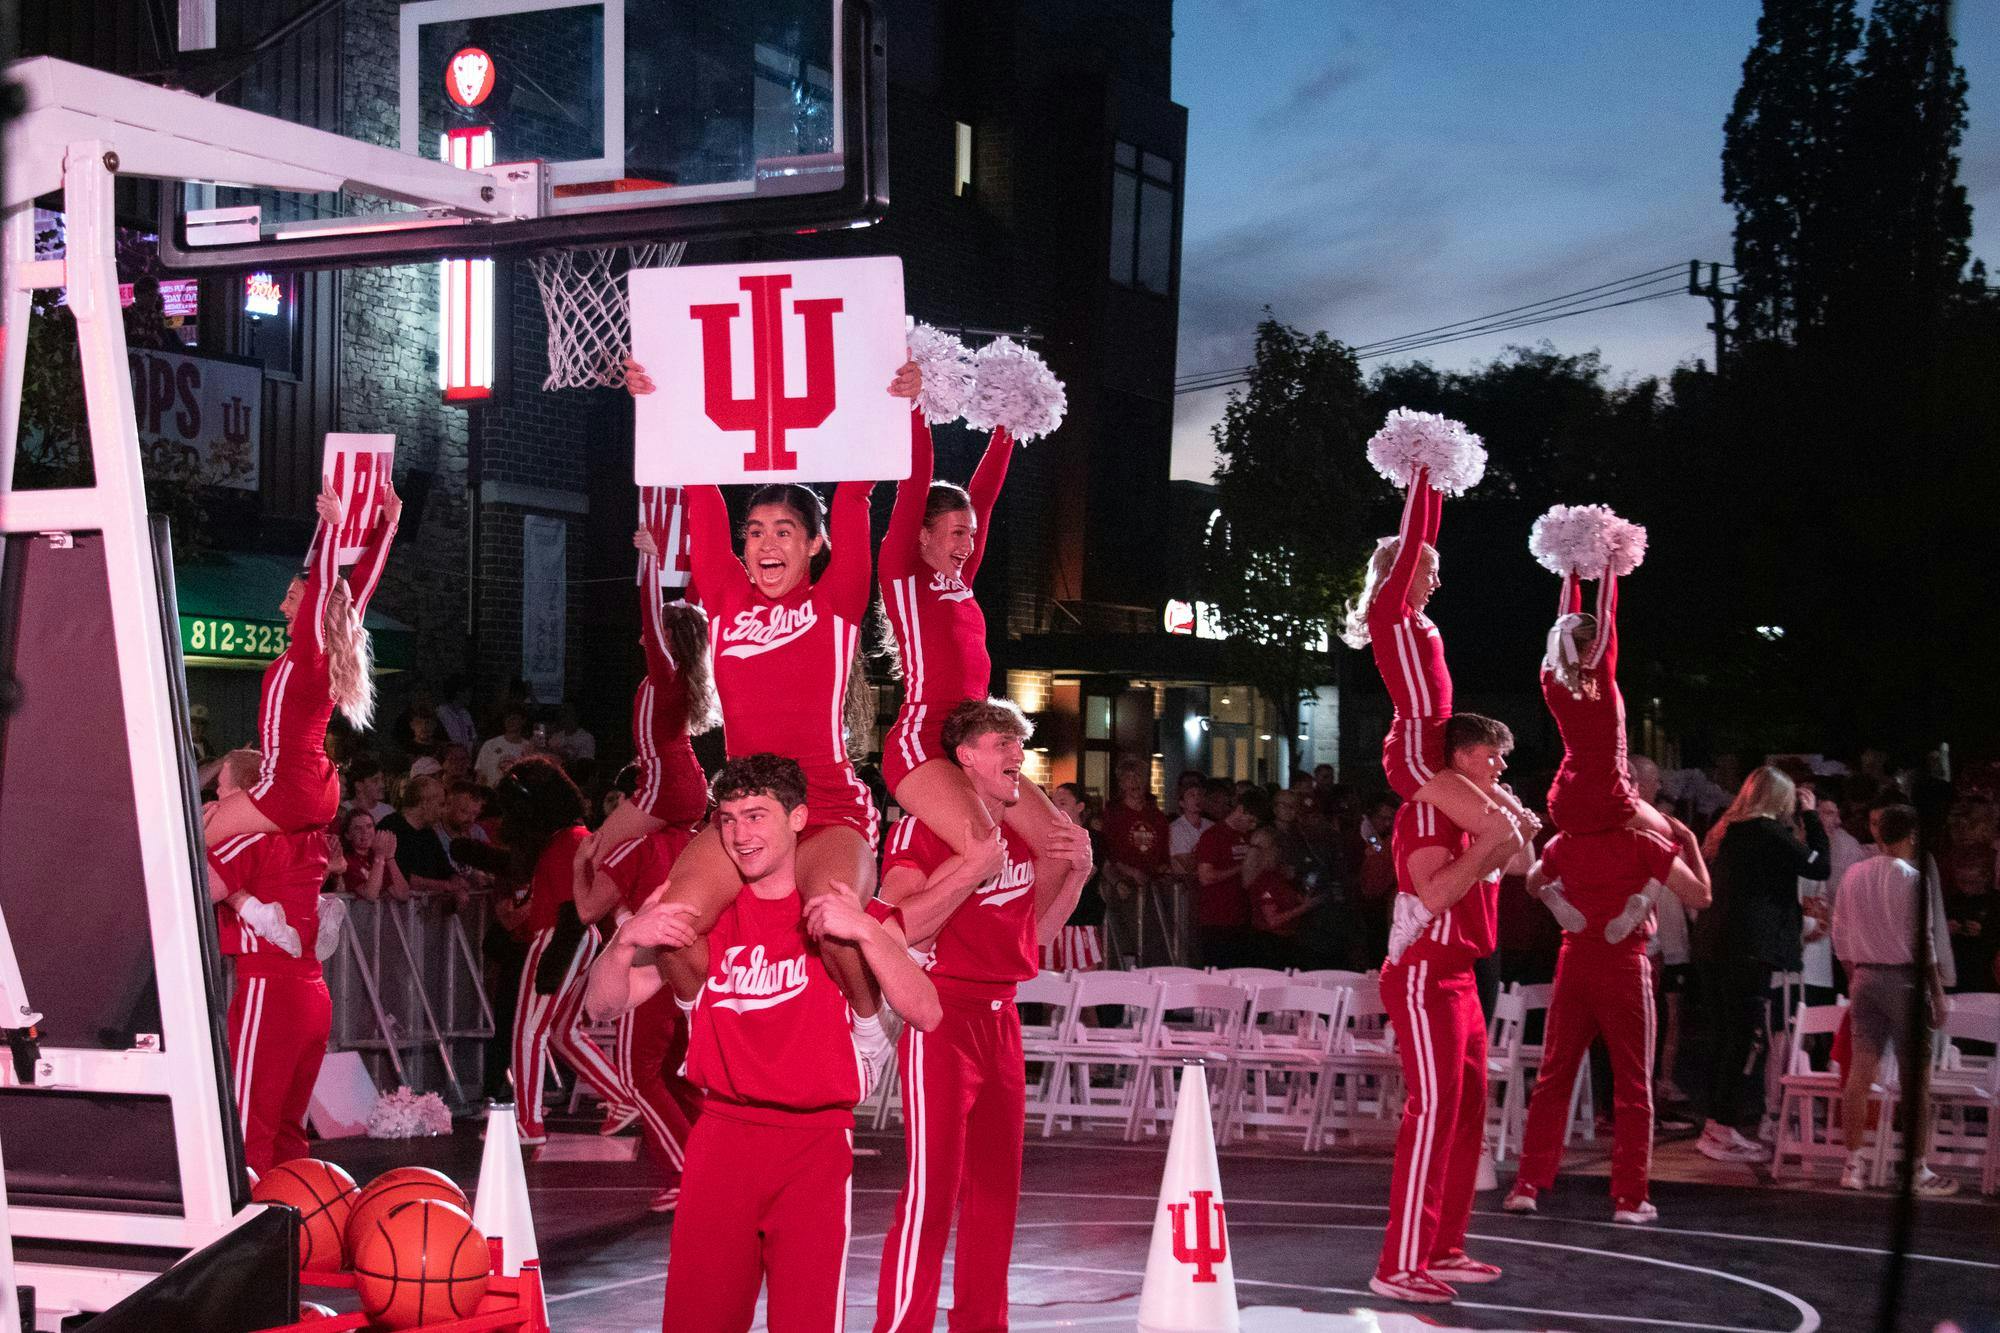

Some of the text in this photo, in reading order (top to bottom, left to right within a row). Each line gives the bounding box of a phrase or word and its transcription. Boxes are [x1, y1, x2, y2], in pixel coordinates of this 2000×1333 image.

[690, 274, 843, 471] IU
[708, 945, 809, 1015] Indiana
[1167, 1191, 1226, 1283] IU
